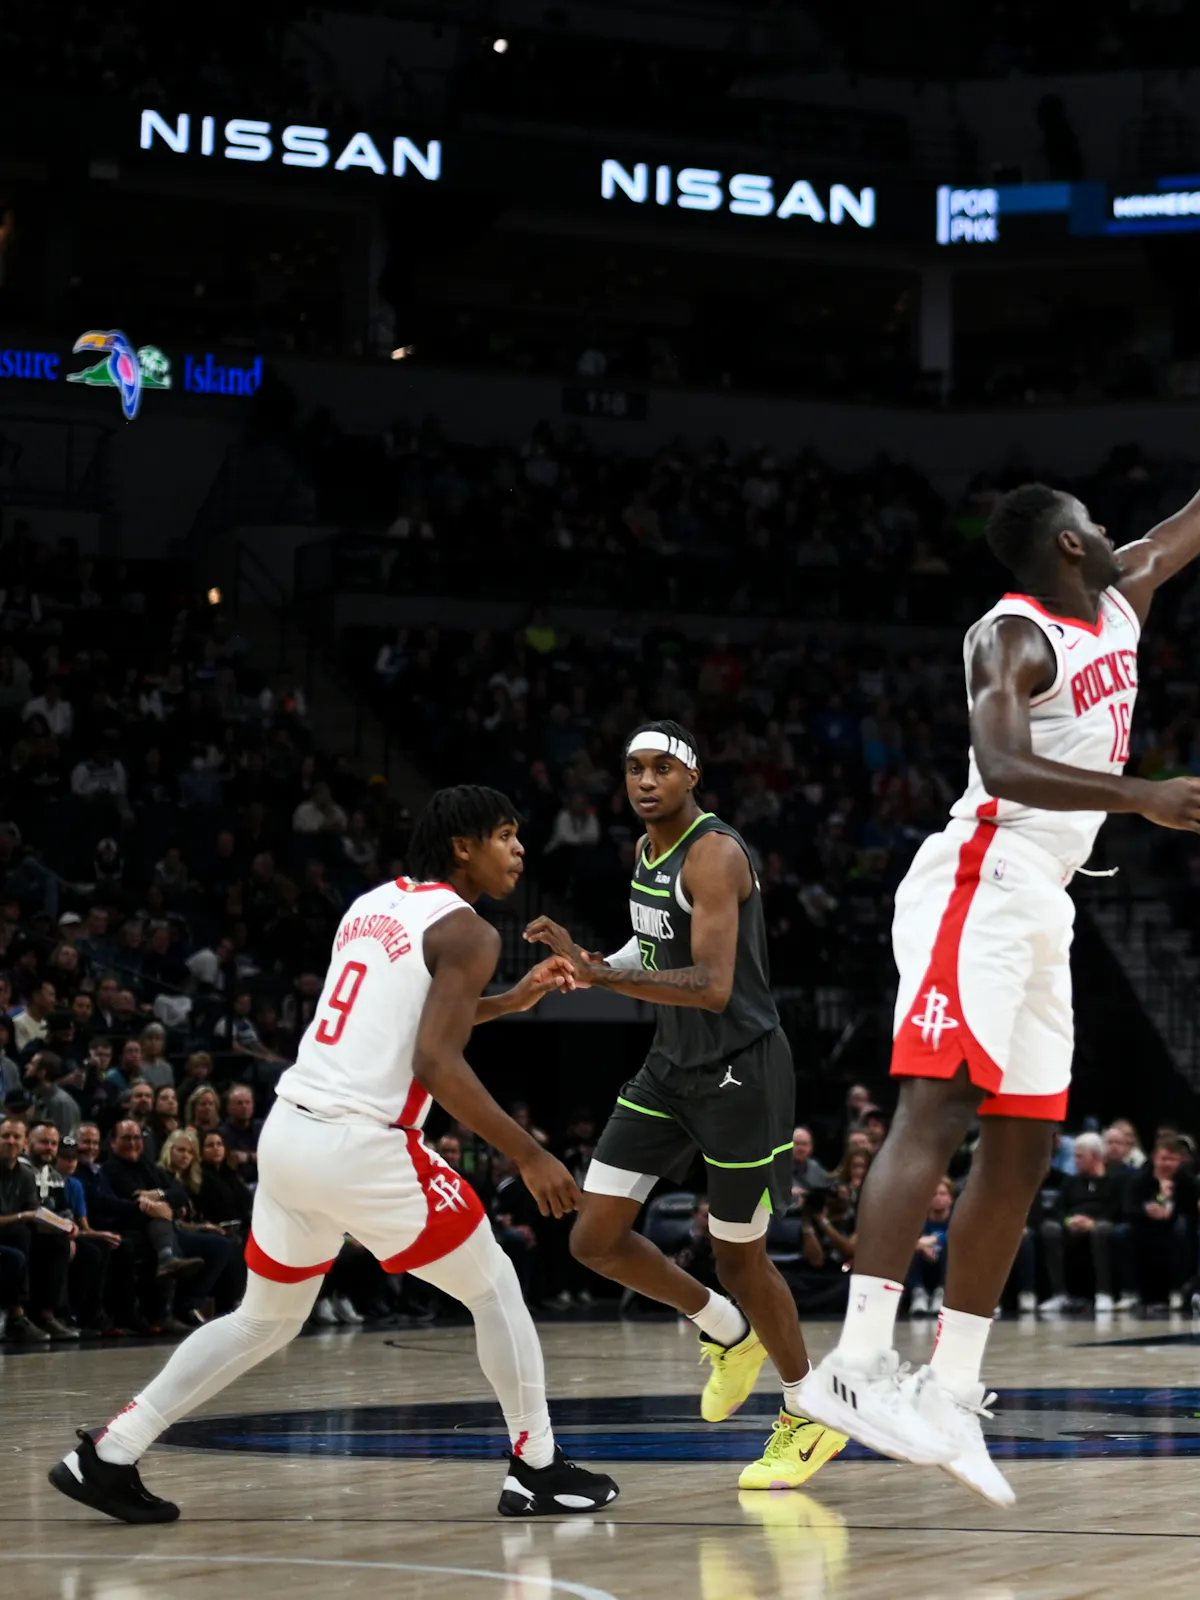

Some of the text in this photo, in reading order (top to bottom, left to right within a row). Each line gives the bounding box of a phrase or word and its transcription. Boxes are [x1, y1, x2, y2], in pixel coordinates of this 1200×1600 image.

[140, 109, 442, 181] NISSAN
[601, 158, 876, 228] NISSAN
[950, 188, 998, 217] POR
[0, 349, 263, 396] sure Island
[337, 914, 412, 963] CHRISTOPHER
[315, 960, 368, 1046] 9
